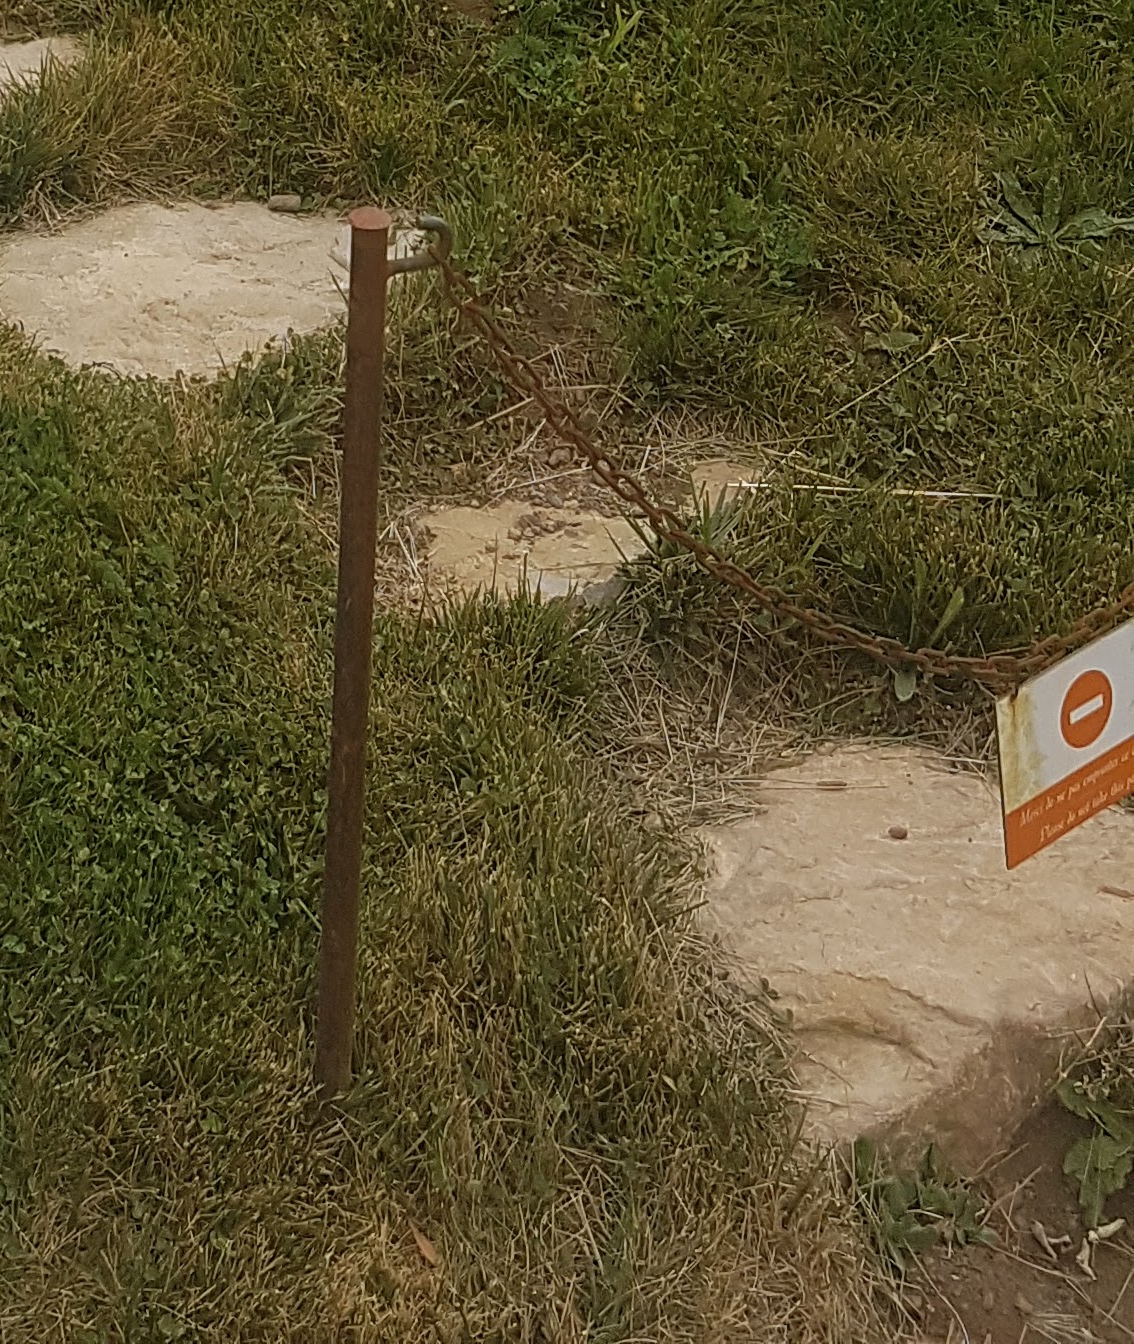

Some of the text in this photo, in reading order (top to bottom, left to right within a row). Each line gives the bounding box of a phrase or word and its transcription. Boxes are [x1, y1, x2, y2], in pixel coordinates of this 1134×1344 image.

[1019, 807, 1043, 828] Merci
[1045, 796, 1054, 811] de
[1067, 783, 1080, 801] pas
[1082, 758, 1118, 787] emprunter
[1039, 820, 1065, 843] Please
[1066, 811, 1076, 825] do
[1077, 800, 1090, 816] not
[1092, 790, 1108, 808] take
[1110, 781, 1124, 797] this
